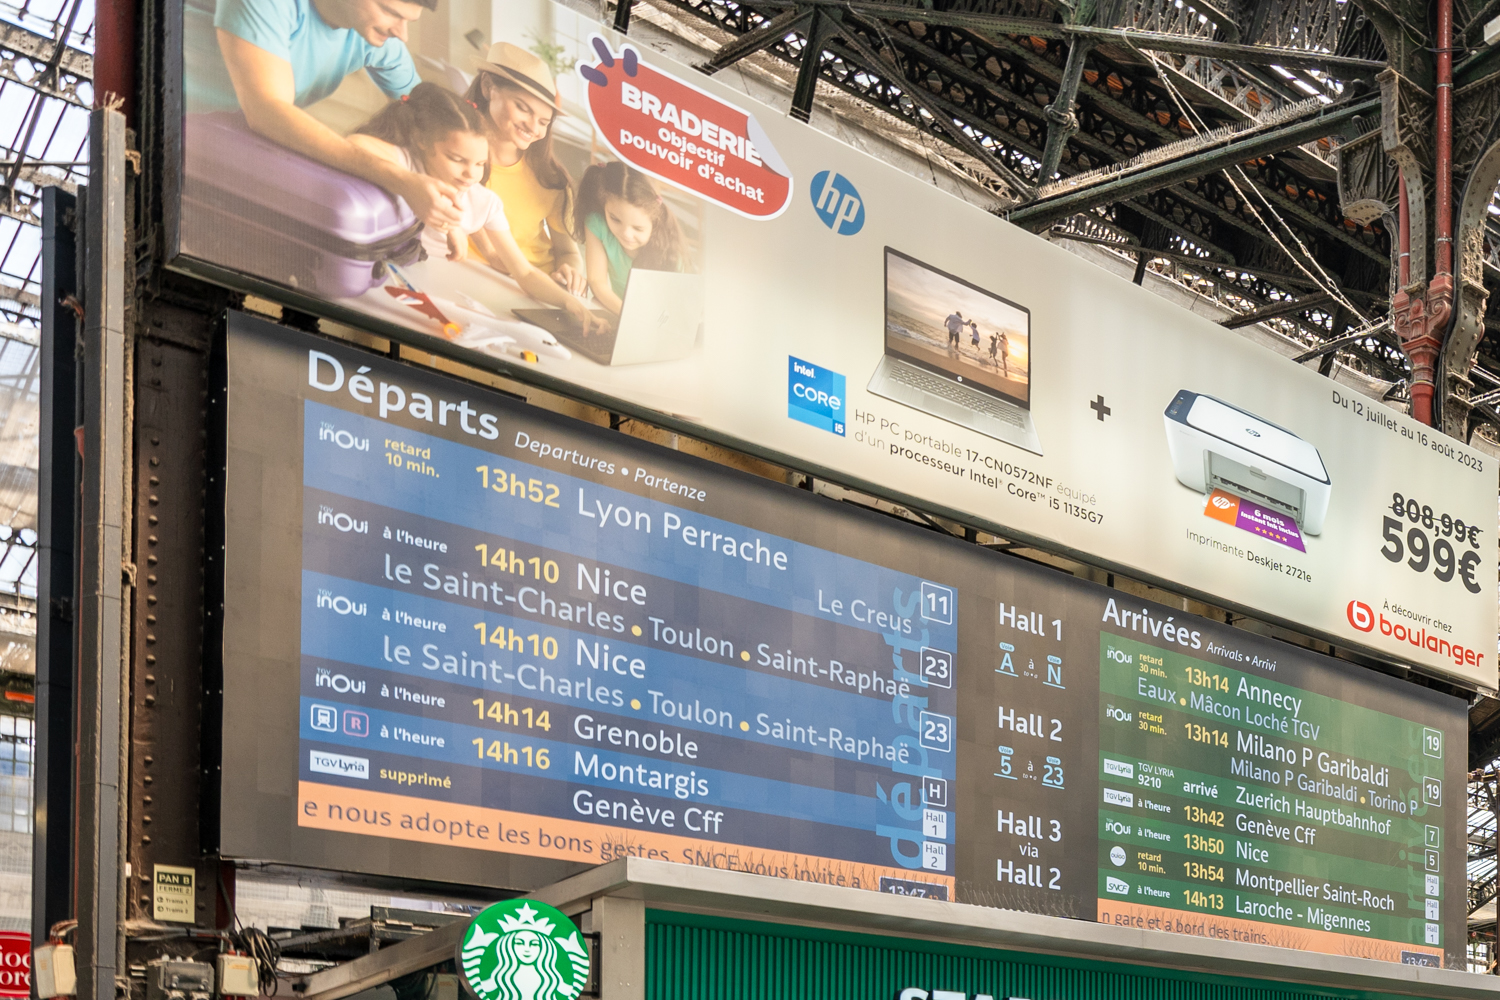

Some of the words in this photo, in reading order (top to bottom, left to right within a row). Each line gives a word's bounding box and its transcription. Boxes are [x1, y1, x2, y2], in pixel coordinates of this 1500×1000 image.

[620, 81, 762, 167] BRADERIE
[619, 127, 691, 171] pouvoir
[698, 161, 765, 204] d'achat
[657, 127, 725, 168] Objectif
[816, 171, 860, 235] hp
[308, 348, 500, 441] Départs
[383, 436, 432, 461] retard
[834, 422, 844, 436] i5
[1332, 390, 1349, 410] Du
[1352, 399, 1364, 417] 12
[1366, 405, 1398, 433] juillet
[1400, 424, 1414, 440] au
[1417, 429, 1429, 447] 16
[1431, 436, 1455, 460] août
[1458, 450, 1484, 473] 2023
[384, 452, 403, 469] 10
[406, 460, 441, 478] min.
[514, 430, 616, 476] Departures
[633, 467, 707, 503] Partenze
[855, 409, 875, 426] HP
[880, 418, 900, 436] PC
[904, 425, 962, 459] portable
[966, 449, 1053, 491] 17-CN0572NF
[1056, 481, 1096, 506] équipé
[890, 441, 966, 479] processeur
[1048, 496, 1060, 511] i5
[1063, 502, 1104, 526] 1135G7
[475, 464, 561, 509] 13h52
[577, 487, 652, 534] Lyon
[663, 511, 789, 572] Perrache
[1240, 511, 1267, 526] Instant
[1254, 508, 1262, 517] 6
[1263, 513, 1286, 527] mois
[1391, 492, 1481, 550] 808,99€
[474, 543, 560, 584] 14h10
[577, 562, 648, 606] Nice
[1186, 528, 1244, 560] Imprimante
[1246, 549, 1283, 575] Deskjet
[1286, 562, 1312, 583] 2721e
[1380, 514, 1482, 594] 599€
[817, 588, 844, 617] Le
[850, 600, 912, 635] Creus
[926, 592, 949, 616] 11
[999, 602, 1045, 638] Hall
[1052, 619, 1063, 641] 1
[1101, 597, 1202, 650] Arrivées
[1392, 601, 1431, 627] découvrir
[1433, 614, 1453, 634] chez
[383, 552, 412, 584] le
[422, 562, 625, 635] Saint-Charles
[648, 615, 735, 660] Toulon
[757, 643, 911, 700] Saint-Raphaë
[1379, 612, 1485, 668] boulanger
[473, 621, 559, 661] 14h10
[575, 638, 647, 680] Nice
[924, 655, 949, 680] 23
[1000, 652, 1015, 673] A
[1047, 664, 1062, 685] N
[1139, 652, 1164, 667] retard
[1206, 641, 1243, 663] Arrivals
[1251, 655, 1277, 672] Arrivi
[382, 634, 412, 666] le
[421, 643, 625, 708] Saint-Charles
[647, 689, 734, 730] Toulon
[755, 712, 910, 764] Saint-Raphaë
[1138, 676, 1177, 705] Eaux
[1190, 691, 1241, 722] Mâcon
[1245, 707, 1289, 734] Loché
[1291, 719, 1320, 742] TGV
[1184, 665, 1230, 694] 13h14
[1236, 676, 1302, 718] Annecy
[350, 716, 362, 731] R
[471, 697, 552, 732] 14h14
[573, 713, 699, 760] Grenoble
[924, 720, 948, 743] 23
[998, 706, 1044, 740] Hall
[1050, 718, 1063, 742] 2
[1426, 735, 1441, 753] 19
[314, 754, 338, 769] TGV
[471, 736, 552, 771] 14h16
[573, 751, 710, 800] Montargis
[1000, 755, 1012, 775] 5
[1043, 764, 1065, 787] 23
[1138, 762, 1151, 775] TGV
[1151, 765, 1175, 779] LYRIA
[1184, 722, 1229, 749] 13h14
[1236, 730, 1297, 766] Milano
[1303, 748, 1313, 767] P
[1317, 753, 1390, 789] Garibaldi
[379, 766, 452, 791] supprimé
[929, 783, 941, 799] H
[1138, 773, 1162, 790] 9210
[1230, 756, 1281, 787] Milano
[1284, 770, 1294, 788] P
[1297, 774, 1359, 804] Garibaldi
[1367, 789, 1408, 815] Torino
[1409, 799, 1419, 816] P
[1426, 783, 1440, 801] 19
[327, 802, 392, 828] nous
[400, 811, 490, 843] adopte
[497, 821, 531, 847] les
[538, 827, 594, 855] bons
[572, 789, 676, 832] Genève
[683, 807, 724, 836] Cff
[997, 809, 1044, 840] Hall
[1049, 819, 1062, 842] 3
[1183, 780, 1219, 799] arrivé
[1235, 786, 1291, 815] Zuerich
[1294, 797, 1392, 837] Hauptbahnhof
[1183, 805, 1225, 828] 13h42
[1235, 814, 1290, 841] Genève
[1293, 824, 1317, 846] Cff
[1018, 843, 1039, 859] via
[1183, 833, 1225, 856] 13h50
[1235, 841, 1270, 864] Nice
[1429, 829, 1436, 843] 7
[159, 873, 180, 885] PAN
[183, 875, 191, 885] B
[996, 858, 1043, 888] Hall
[1048, 867, 1062, 891] 2
[1429, 854, 1436, 867] 5
[1183, 861, 1225, 883] 13h54
[1235, 867, 1320, 901] Montpellier
[1323, 883, 1396, 912] Saint-Roch
[1183, 889, 1225, 911] 14h13
[1235, 895, 1293, 921] Laroche
[1306, 908, 1372, 934] Migennes
